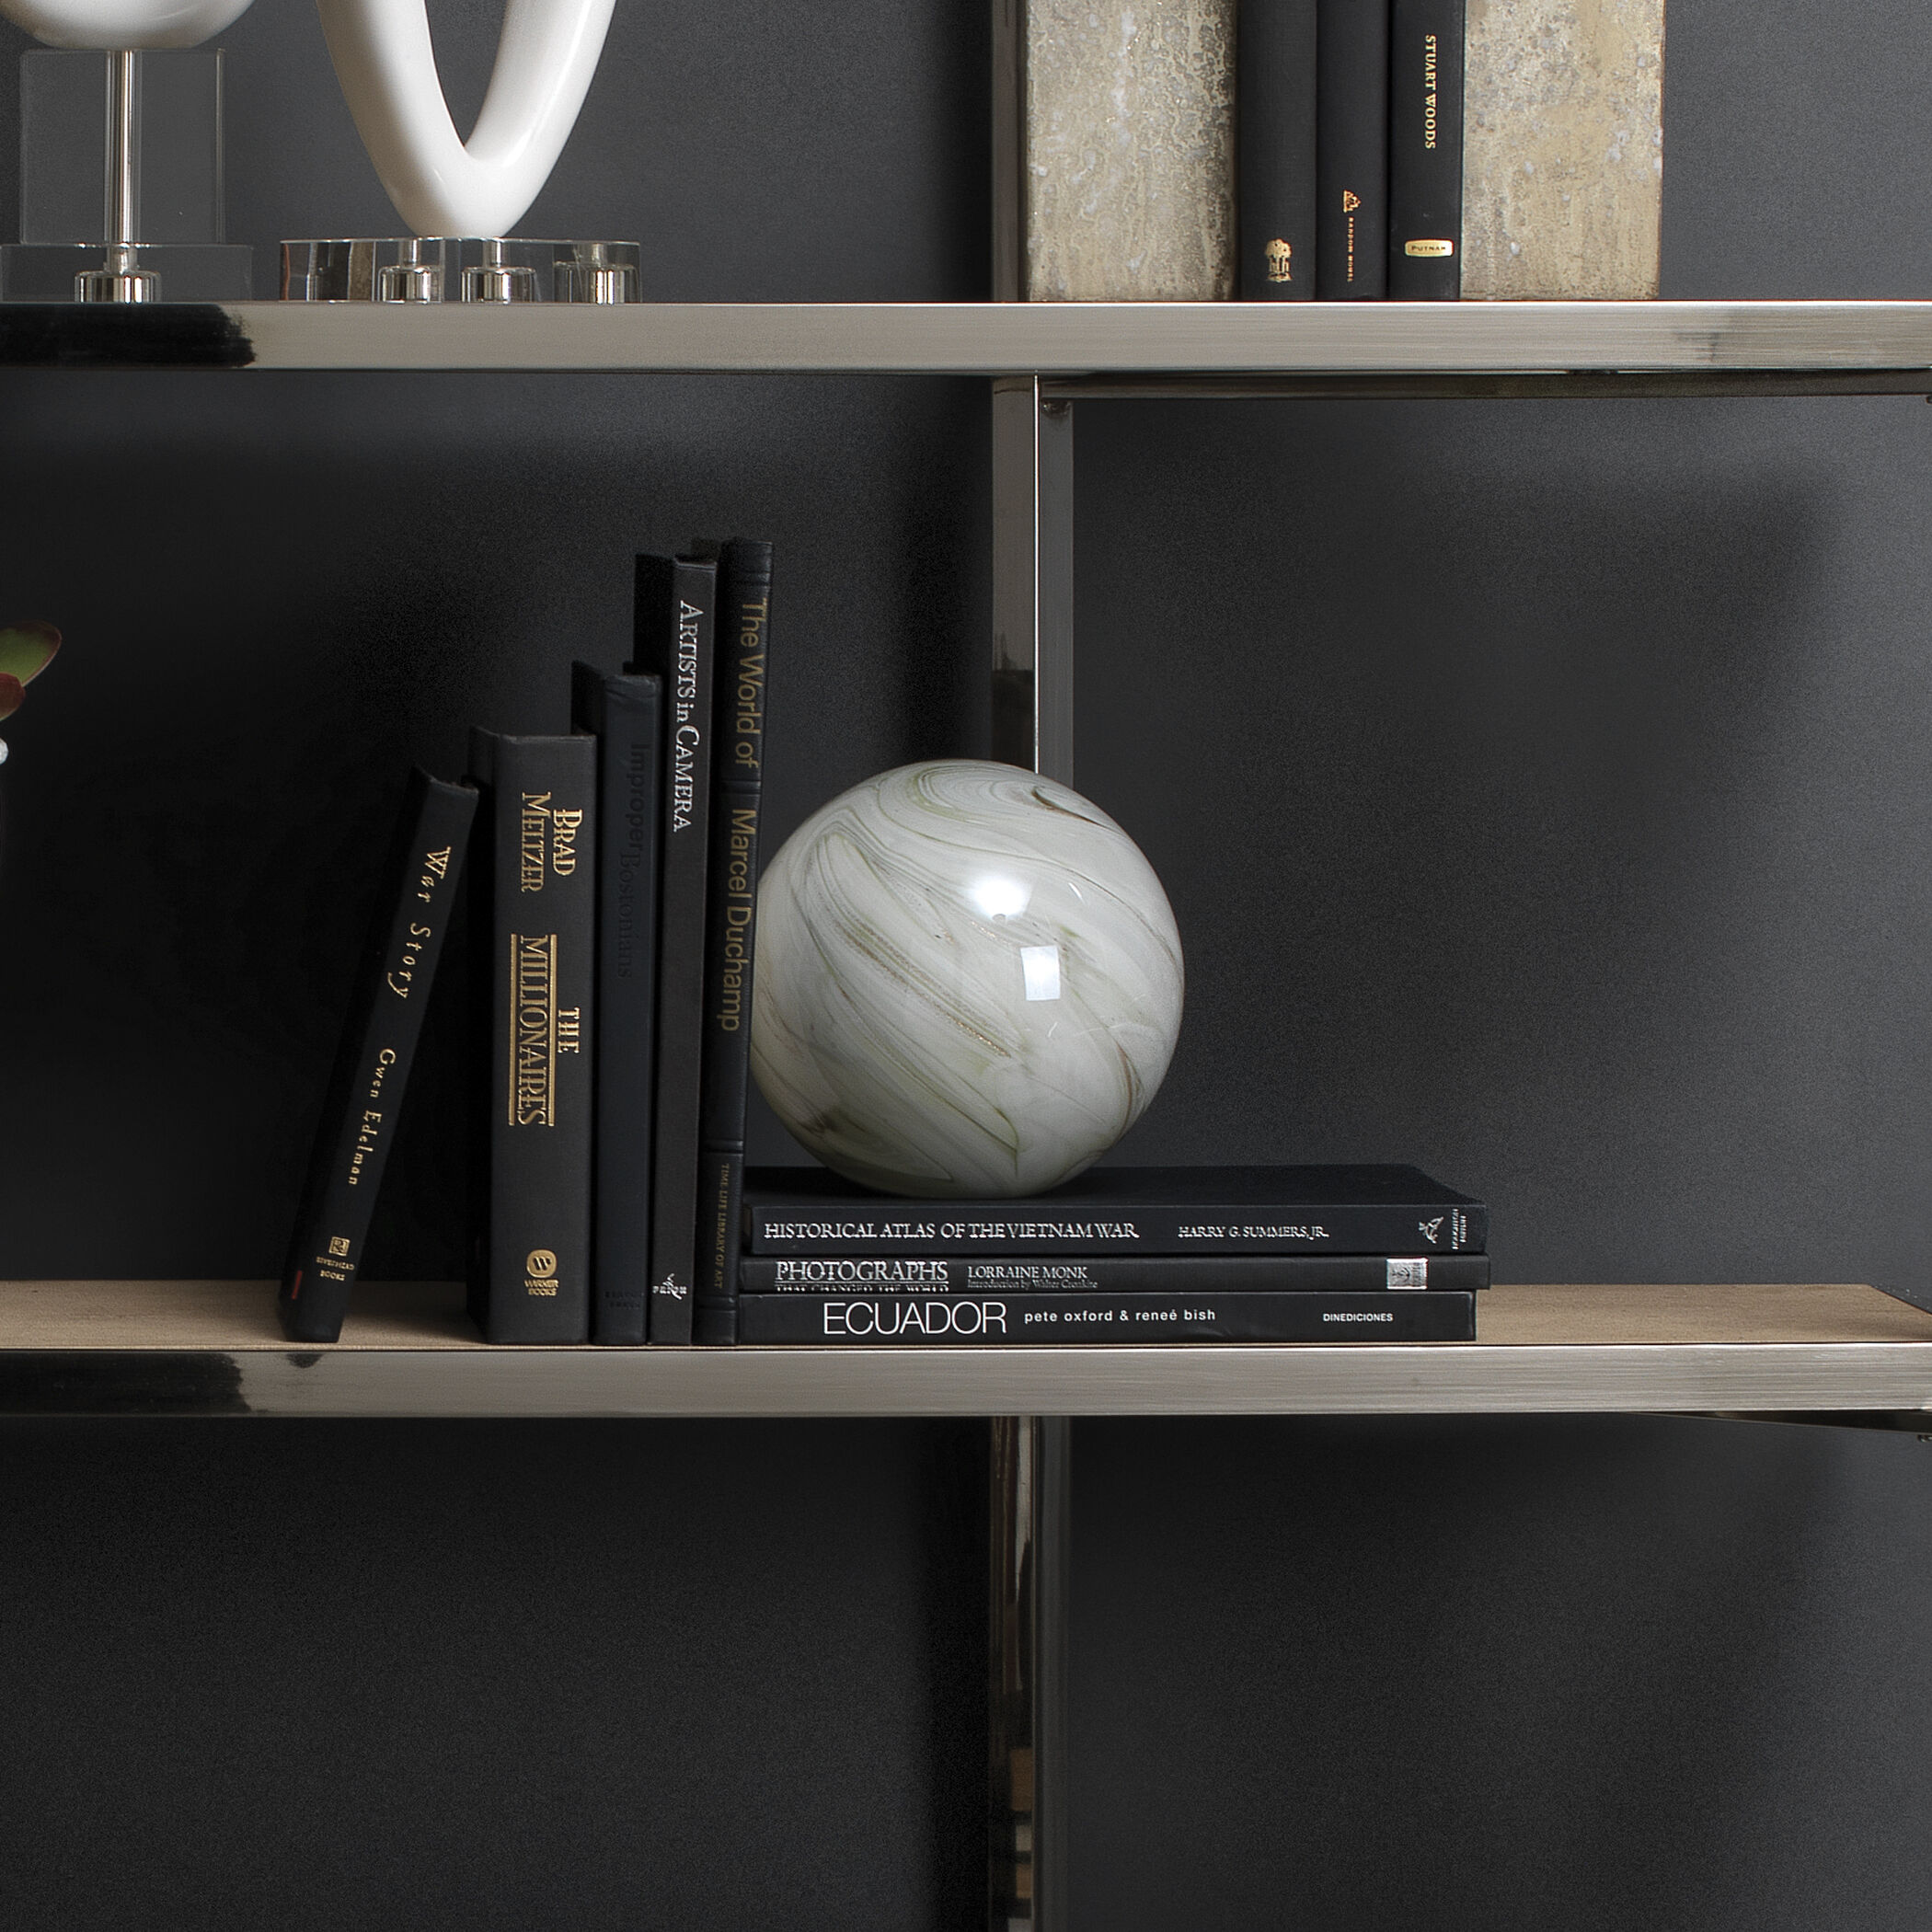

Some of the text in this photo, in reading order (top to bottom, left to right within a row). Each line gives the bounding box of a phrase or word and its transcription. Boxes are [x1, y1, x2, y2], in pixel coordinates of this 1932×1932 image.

[1424, 34, 1437, 149] STUART WOODS
[673, 600, 704, 832] ARTISTS in CAMERA
[626, 743, 652, 851] Improper
[717, 597, 767, 1031] The World of Marcel Duchamp
[521, 791, 551, 892] MELTZER
[553, 809, 583, 876] BRAD
[387, 846, 452, 998] War Story
[517, 935, 549, 1125] MILLIONAIRES
[558, 1006, 581, 1053] THE
[348, 1048, 397, 1185] Gwen Edelman
[716, 1213, 727, 1252] LIBRARY
[765, 1223, 1140, 1238] HISTORICAL ATLAS OF THE VIETNAM WAR
[1178, 1225, 1225, 1238] HARRY
[1228, 1225, 1241, 1238] G.
[714, 1270, 723, 1289] ART
[775, 1259, 949, 1281] PHOTOGRAPHS
[968, 1266, 1088, 1279] LORRAINE MONK
[1020, 1279, 1030, 1290] by
[823, 1301, 1215, 1335] ECUADOR pete oxford & reneé bish
[1323, 1313, 1394, 1322] DINEDICIONES
